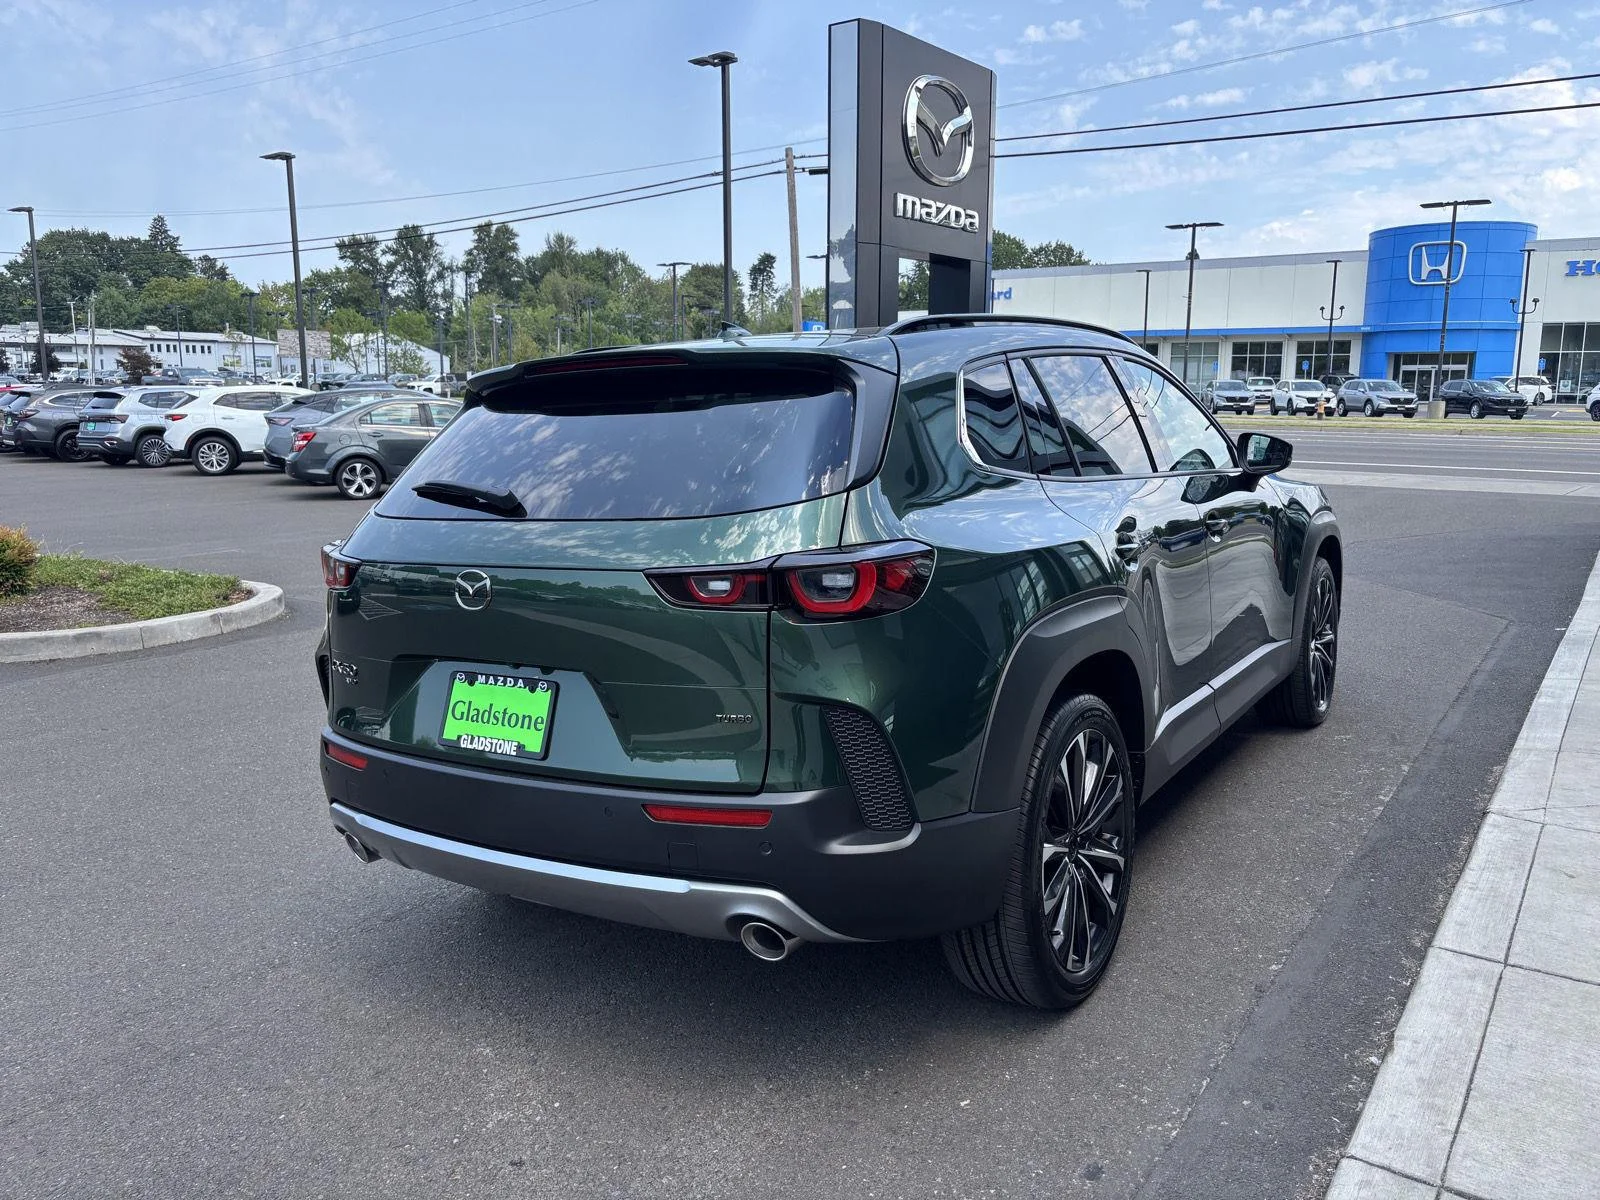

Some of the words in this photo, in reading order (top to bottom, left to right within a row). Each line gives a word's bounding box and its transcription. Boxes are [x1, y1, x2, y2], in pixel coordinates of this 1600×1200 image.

[1566, 260, 1600, 276] H
[477, 674, 525, 688] MAZDA
[451, 700, 545, 732] Gladstone
[716, 714, 752, 723] TURBO
[460, 734, 518, 756] GLADSTONE
